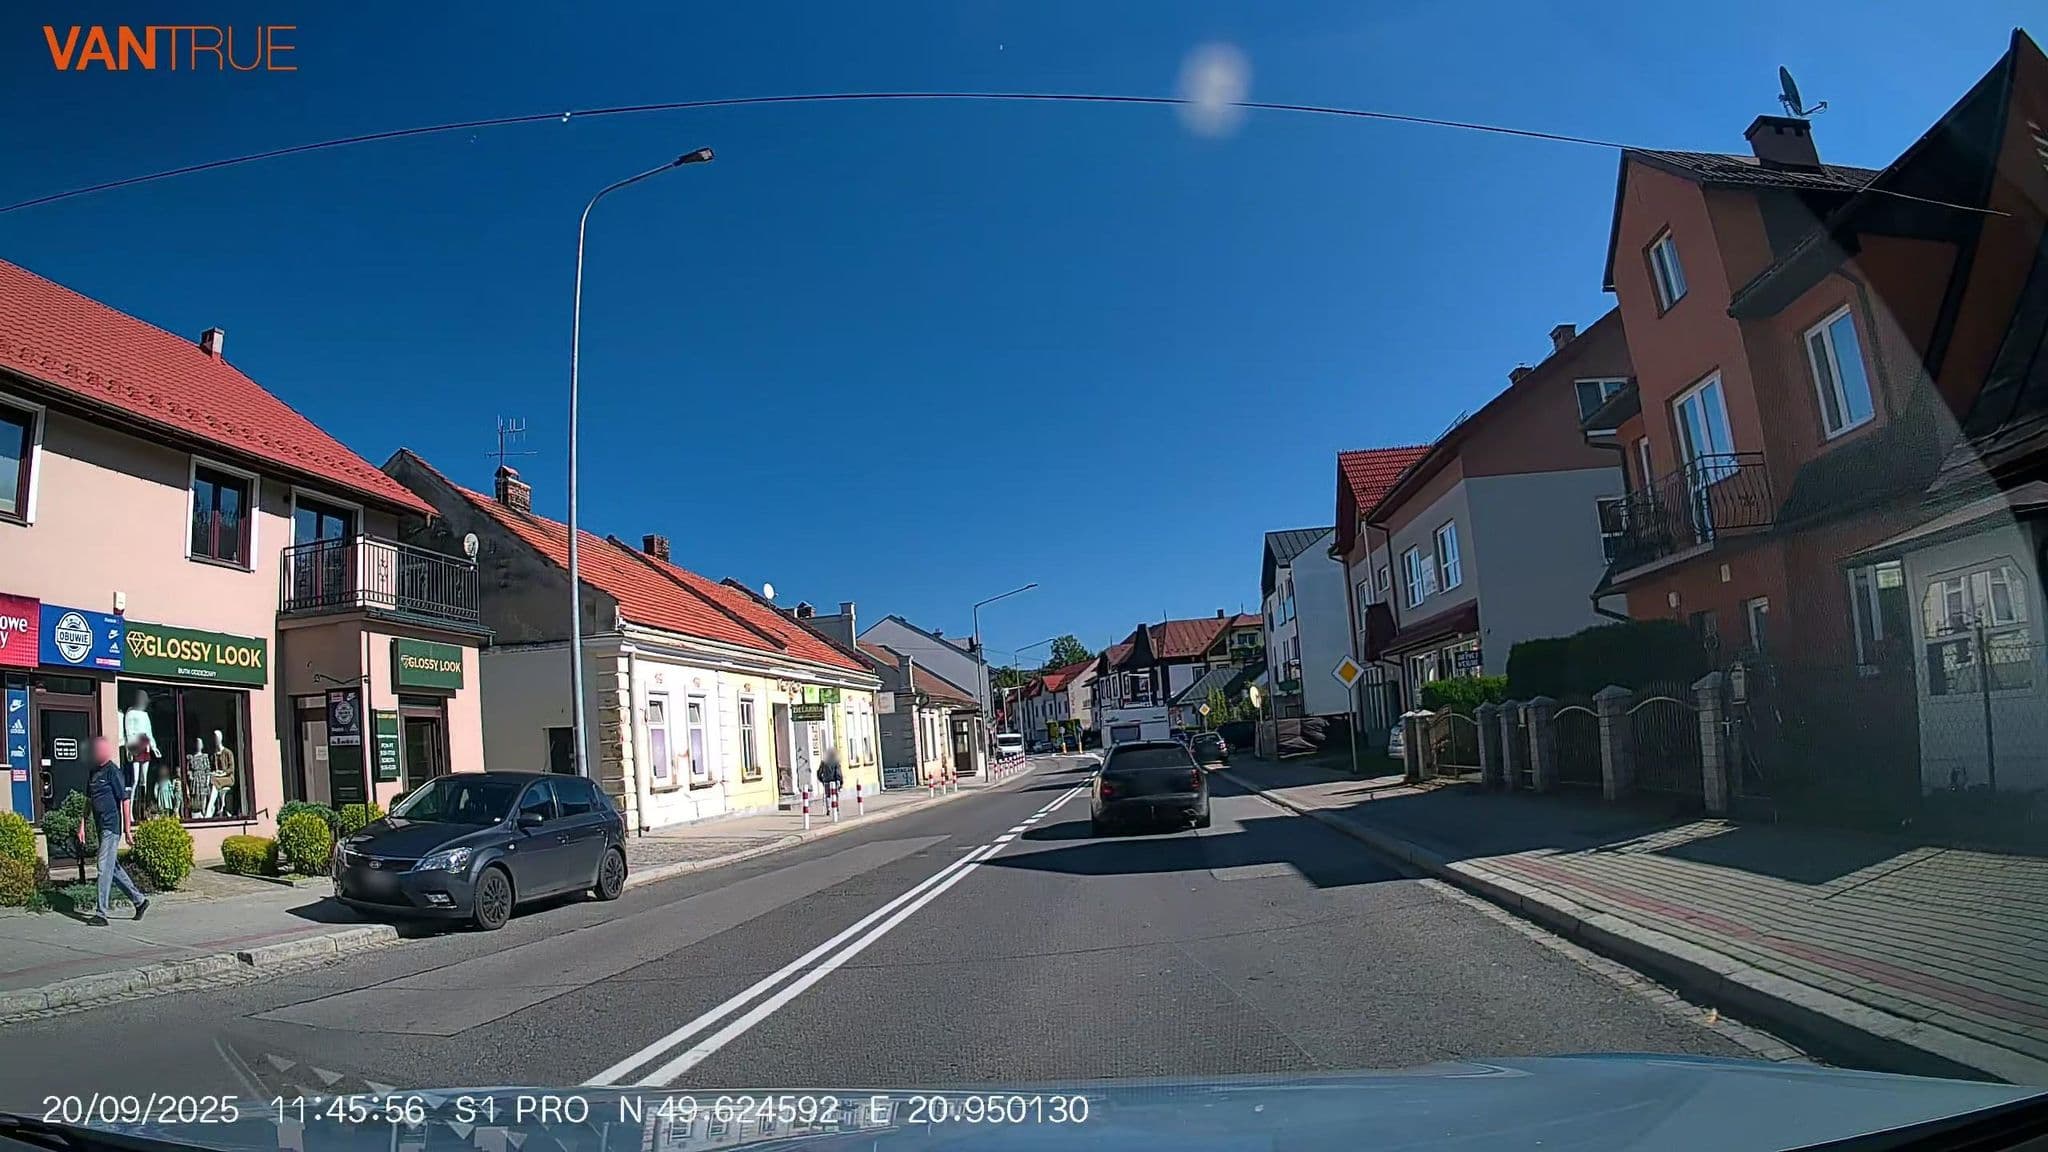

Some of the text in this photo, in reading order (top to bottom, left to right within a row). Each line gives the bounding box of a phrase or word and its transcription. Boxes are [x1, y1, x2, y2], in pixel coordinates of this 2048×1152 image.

[59, 631, 89, 644] OBUWIE
[144, 635, 262, 668] GLOSSY LOOK
[408, 656, 462, 673] GLOSSY LOOK
